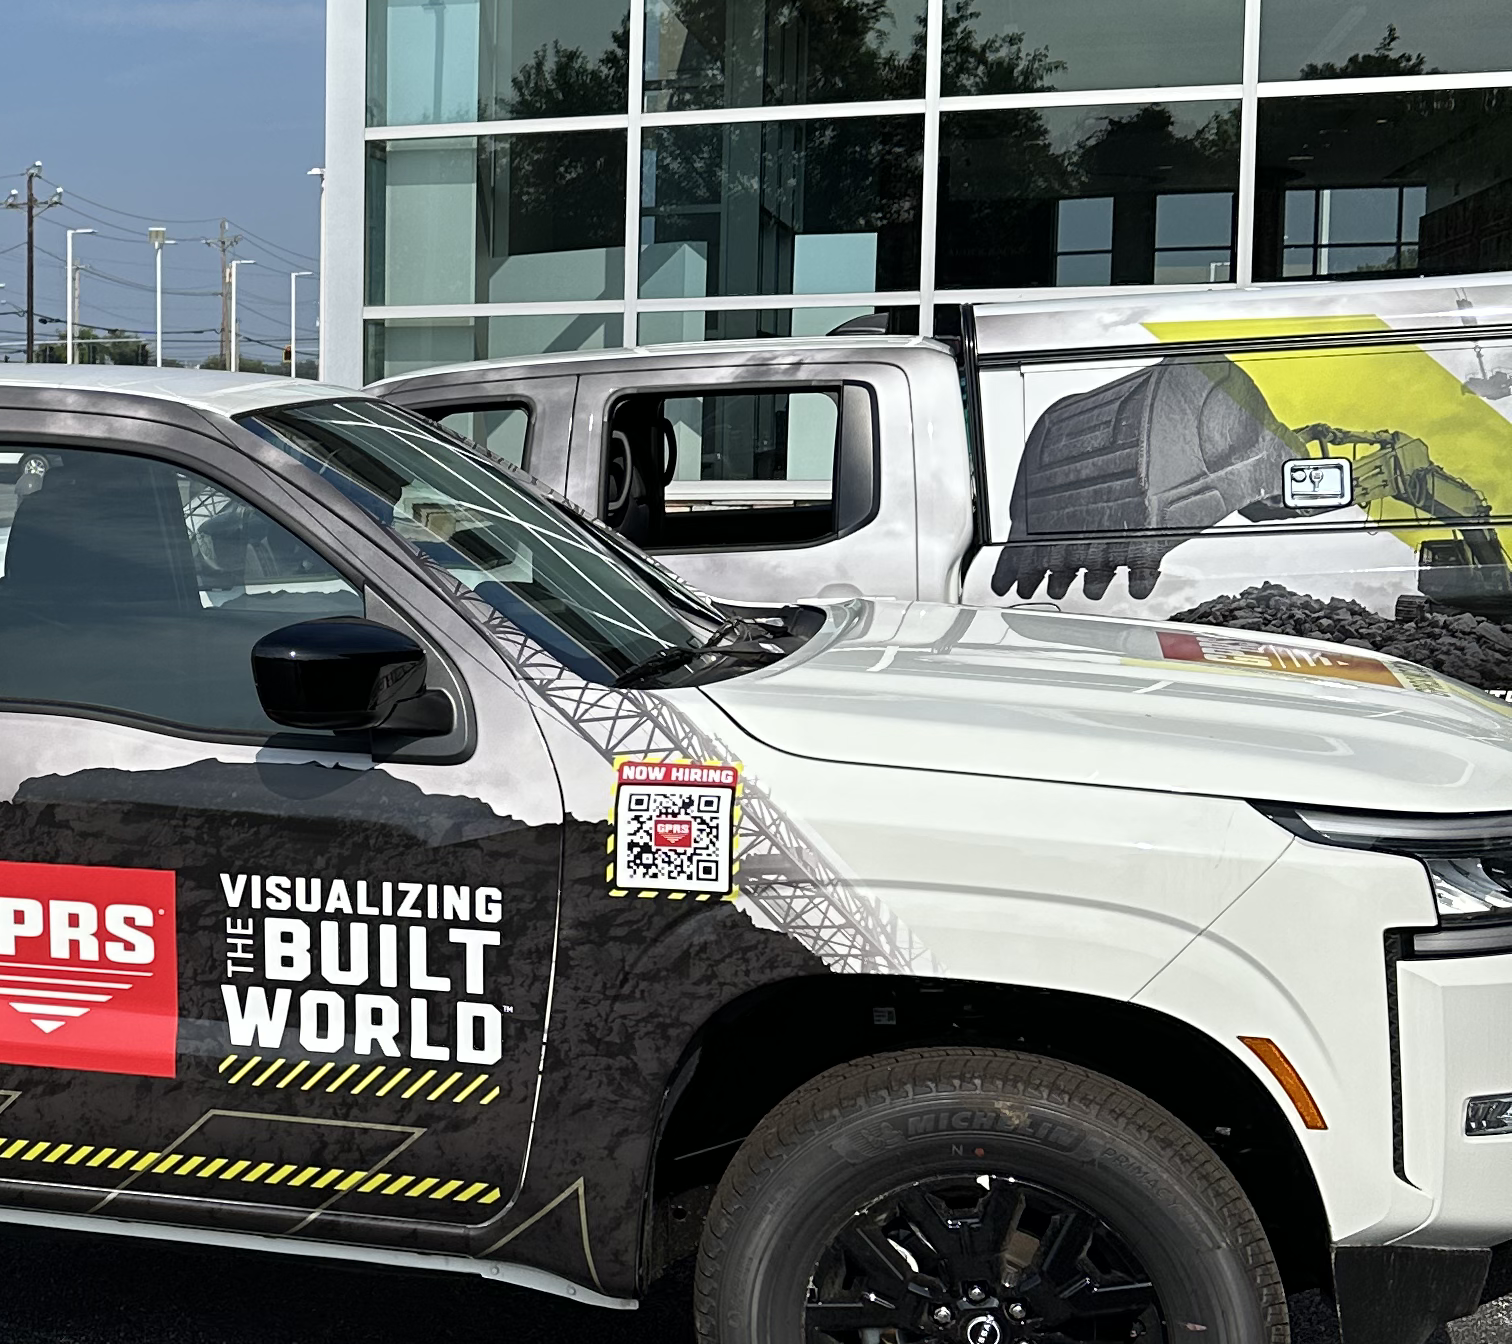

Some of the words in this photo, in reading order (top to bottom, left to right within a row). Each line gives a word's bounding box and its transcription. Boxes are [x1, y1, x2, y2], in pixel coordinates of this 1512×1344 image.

[622, 765, 666, 780] NOW
[671, 768, 734, 782] HIRING
[657, 823, 689, 834] GPRS
[220, 873, 502, 923] VISUALIZING
[227, 917, 253, 977] THE
[264, 918, 501, 993] BUILT
